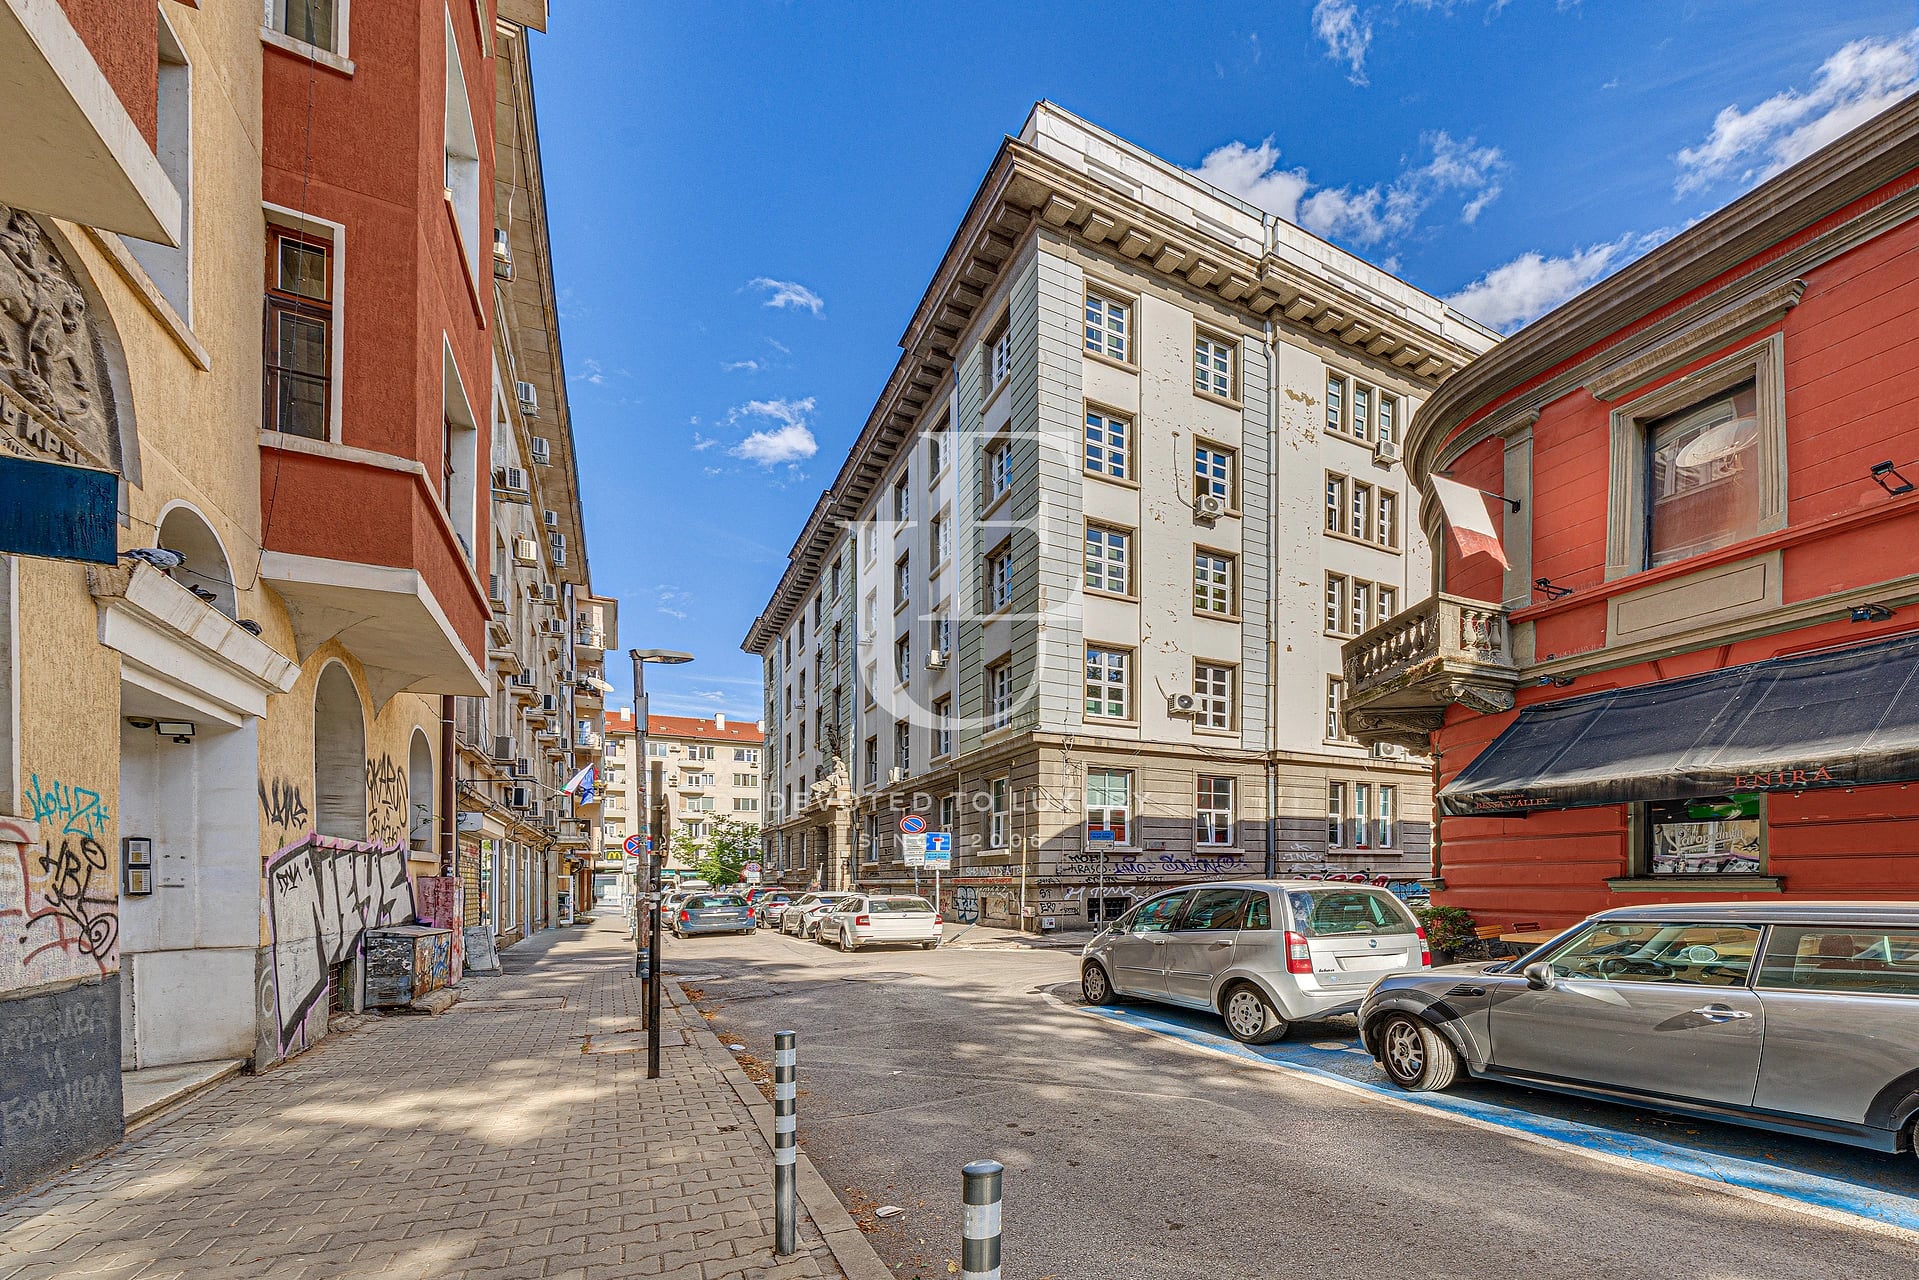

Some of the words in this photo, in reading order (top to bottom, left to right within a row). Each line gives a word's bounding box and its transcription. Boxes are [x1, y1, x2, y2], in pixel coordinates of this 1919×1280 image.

[1735, 765, 1833, 788] ENIRA
[1475, 801, 1504, 810] BESSA
[1508, 798, 1553, 807] VALLEY
